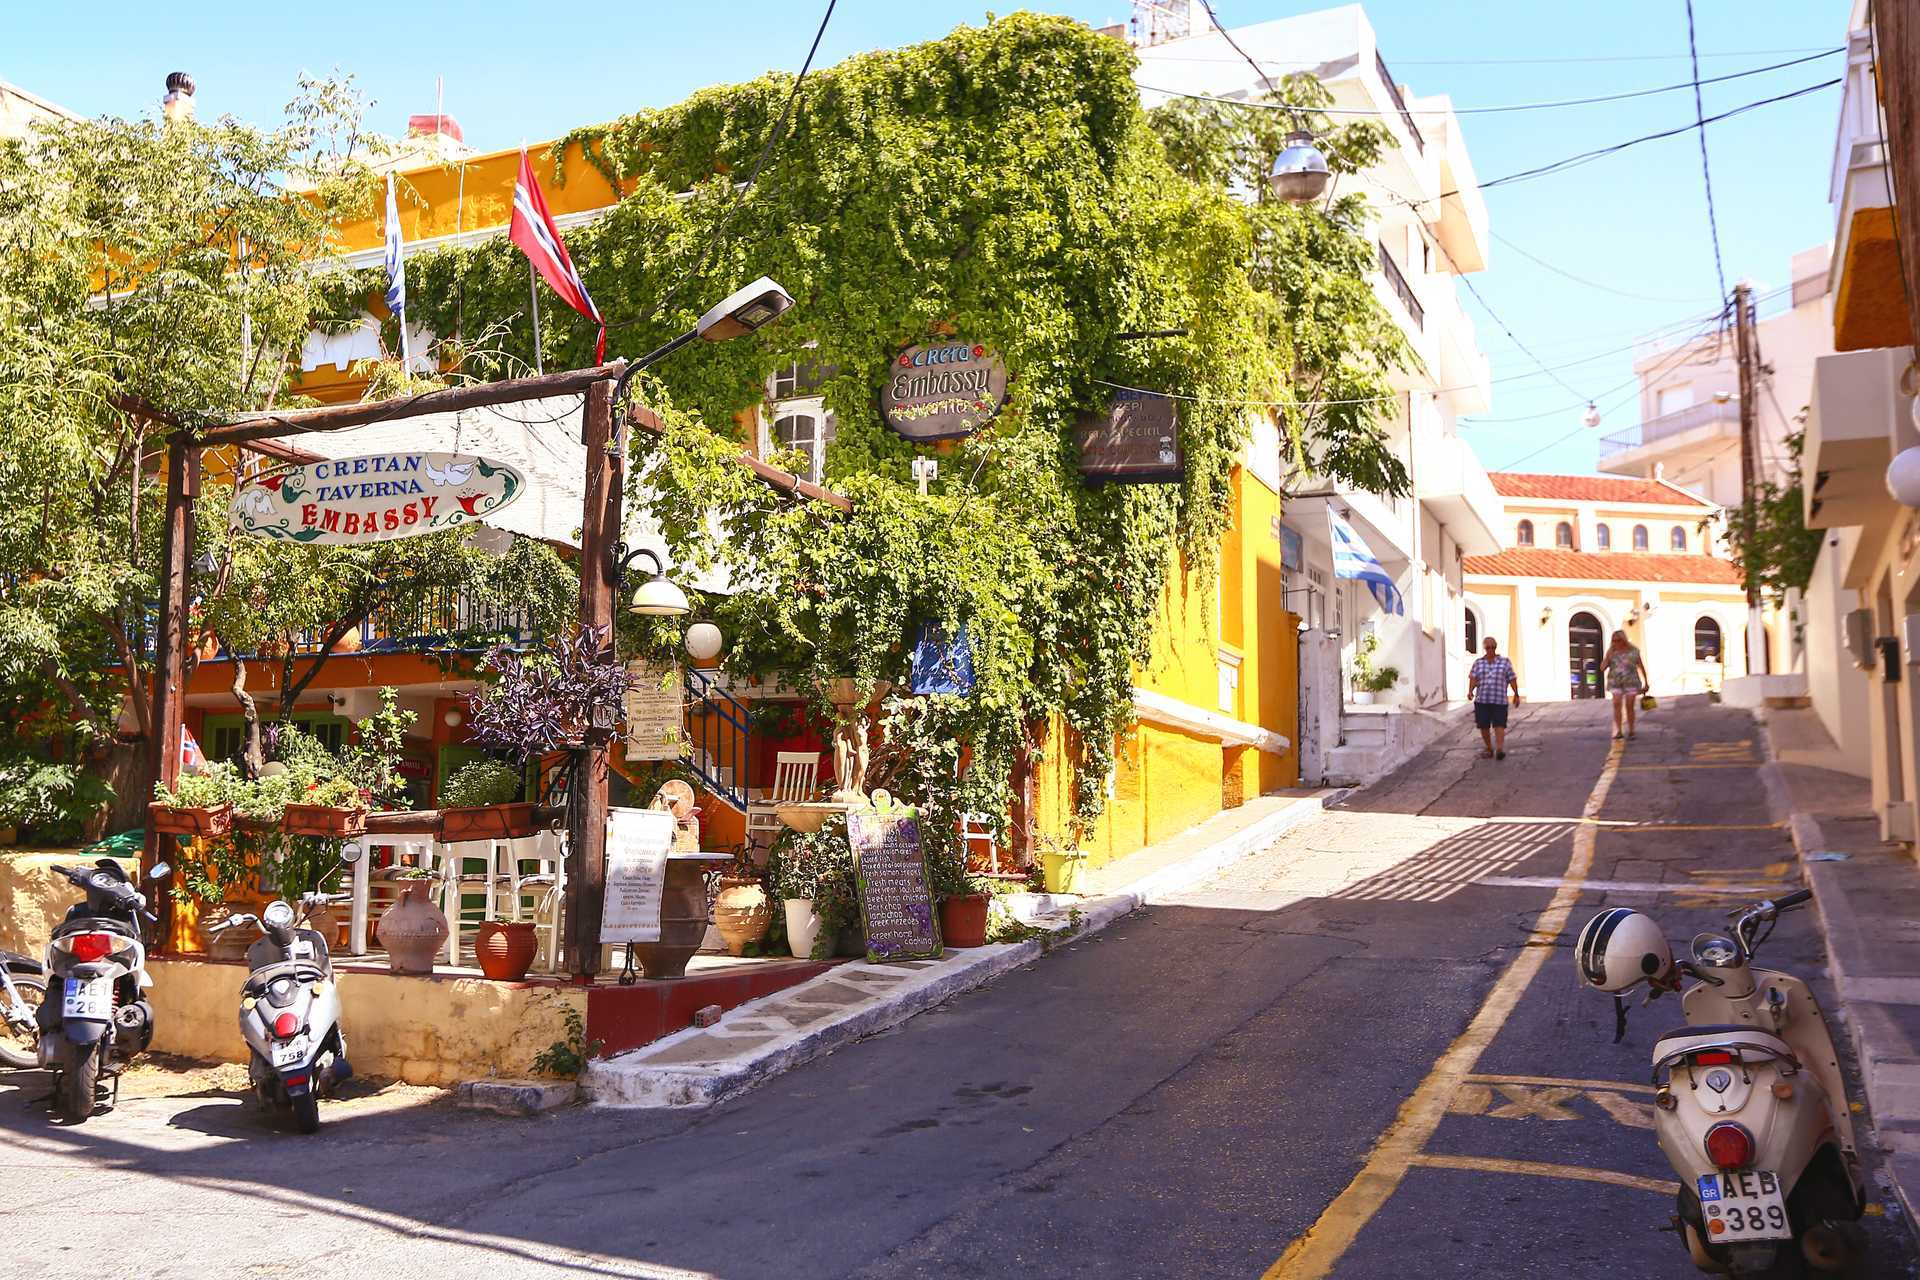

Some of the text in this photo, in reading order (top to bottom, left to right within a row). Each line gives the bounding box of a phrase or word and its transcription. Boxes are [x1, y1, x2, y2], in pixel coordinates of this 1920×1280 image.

[891, 369, 988, 401] Embassy
[316, 456, 424, 480] CRETAN
[315, 479, 424, 501] TAVERNA
[300, 496, 439, 535] EMBASSY
[904, 936, 933, 949] cooking
[279, 1050, 304, 1063] 758
[1727, 1204, 1784, 1232] 389
